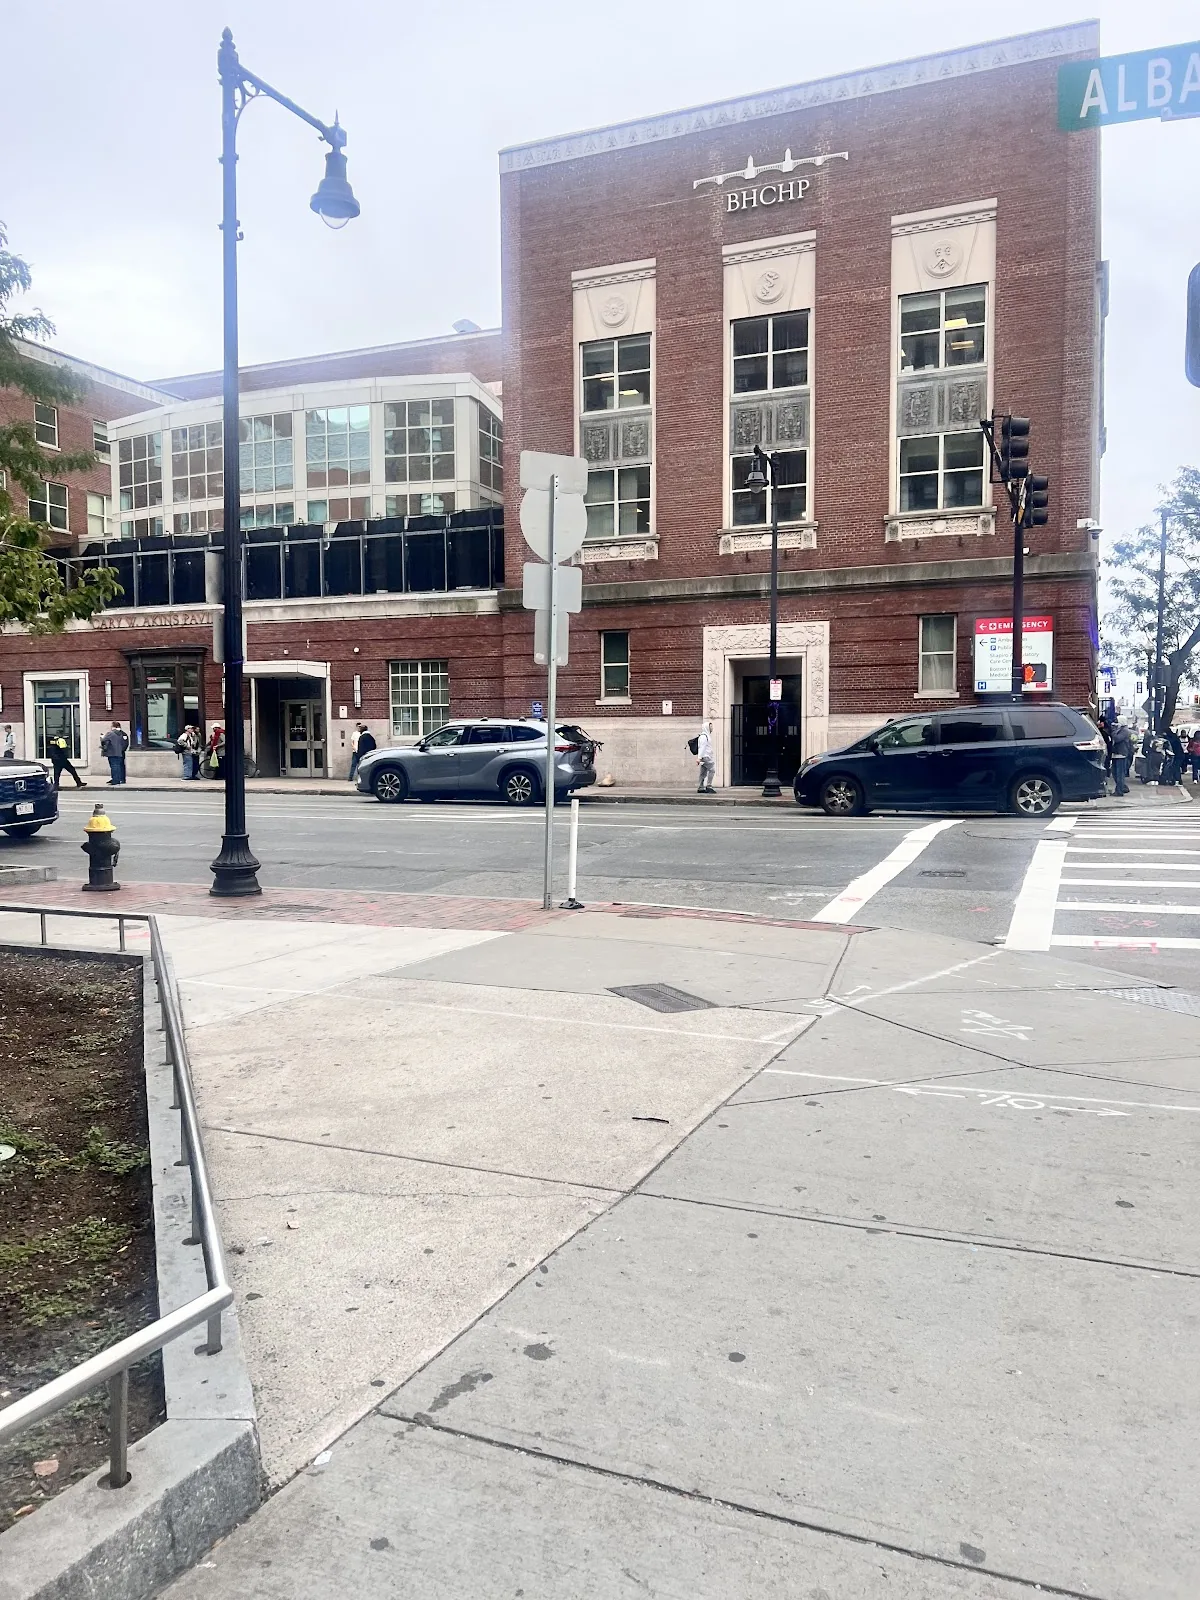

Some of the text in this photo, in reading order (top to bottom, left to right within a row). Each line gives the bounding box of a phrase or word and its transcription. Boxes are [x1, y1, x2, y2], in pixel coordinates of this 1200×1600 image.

[1080, 52, 1200, 118] ALBA
[727, 179, 810, 212] BHCHP
[183, 612, 213, 625] PAVI
[998, 620, 1048, 629] EMEGENCY
